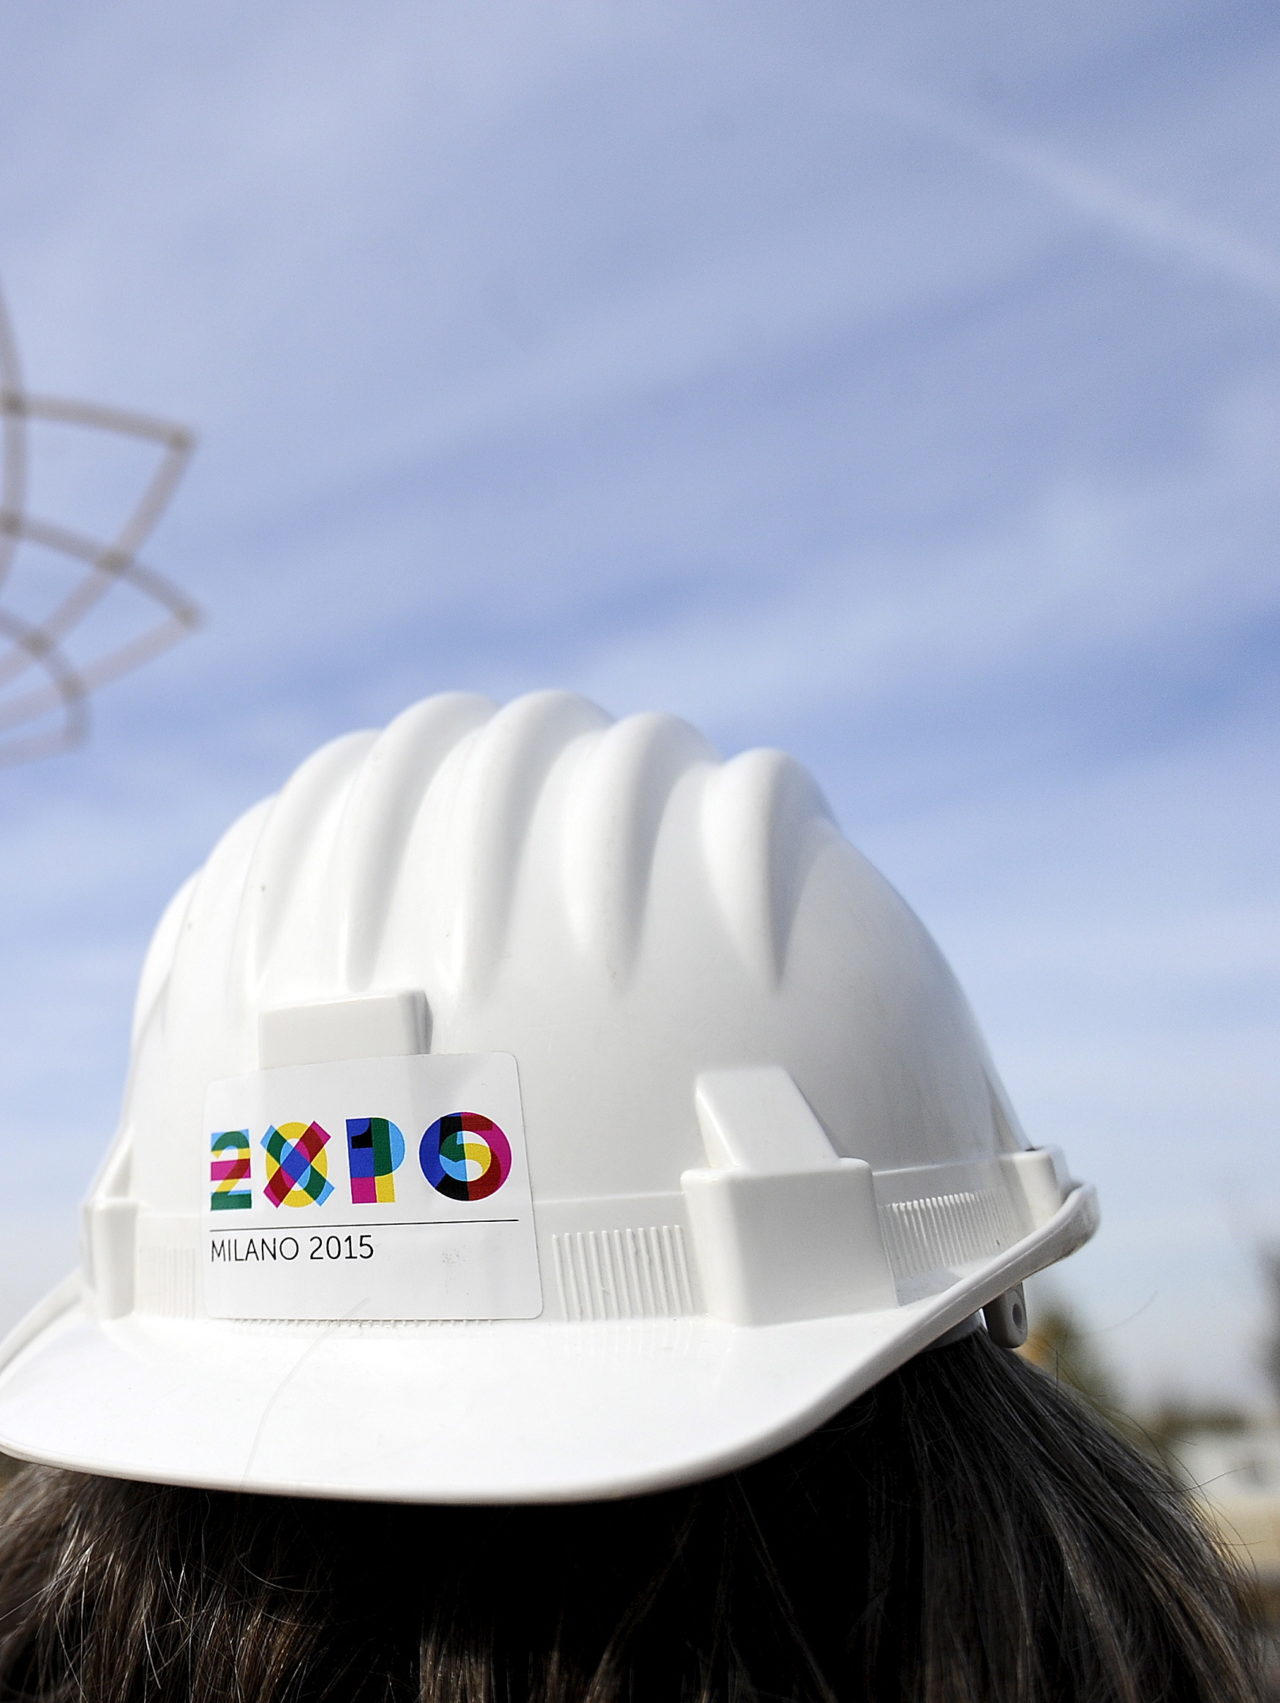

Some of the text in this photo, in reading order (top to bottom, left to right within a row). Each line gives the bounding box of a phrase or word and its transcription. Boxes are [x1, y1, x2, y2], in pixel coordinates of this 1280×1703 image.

[210, 1111, 512, 1211] EXPO
[210, 1234, 375, 1263] MILANO 2015
